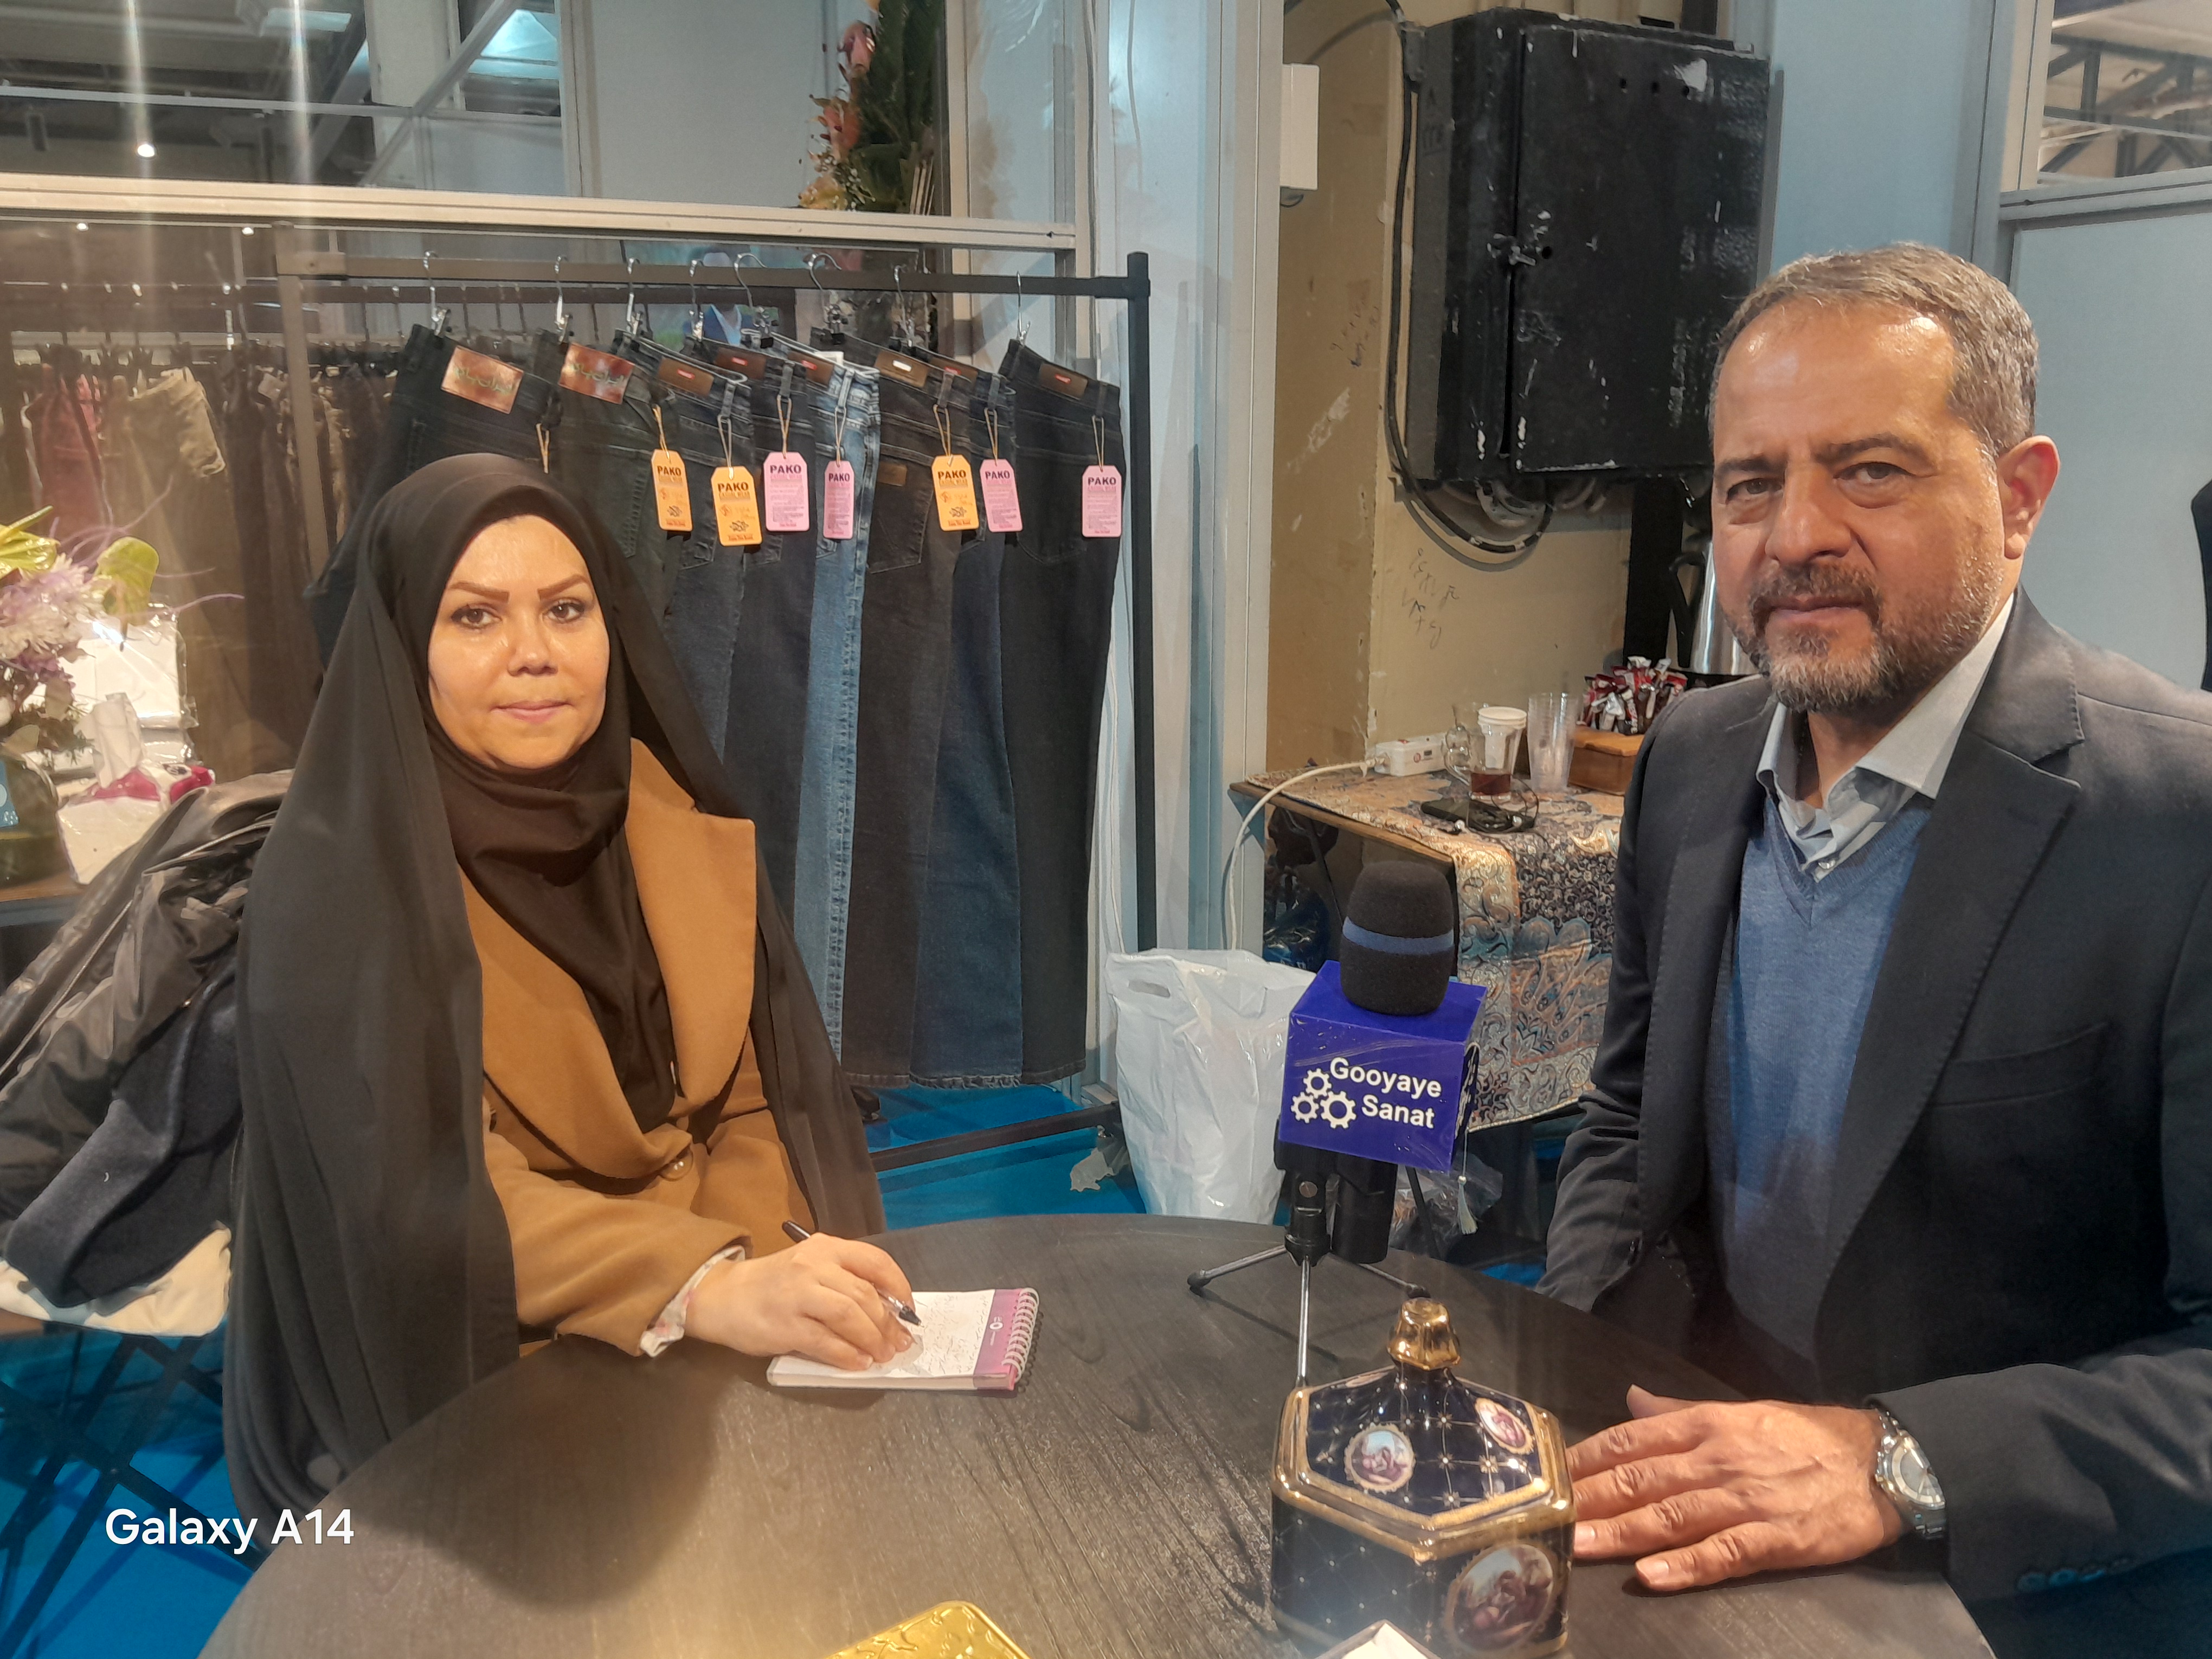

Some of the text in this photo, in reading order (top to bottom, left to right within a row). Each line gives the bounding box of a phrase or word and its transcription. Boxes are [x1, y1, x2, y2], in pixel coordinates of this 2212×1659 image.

[657, 466, 681, 477] PAKO
[770, 464, 802, 474] PAKO
[828, 472, 850, 482] PAKO
[937, 470, 967, 480] PAKO
[985, 470, 1010, 480] PAKO
[1088, 477, 1116, 486] PAKO
[717, 482, 749, 493] PAKO
[1330, 1057, 1442, 1099] Gooyaye
[1361, 1094, 1435, 1129] Sanat
